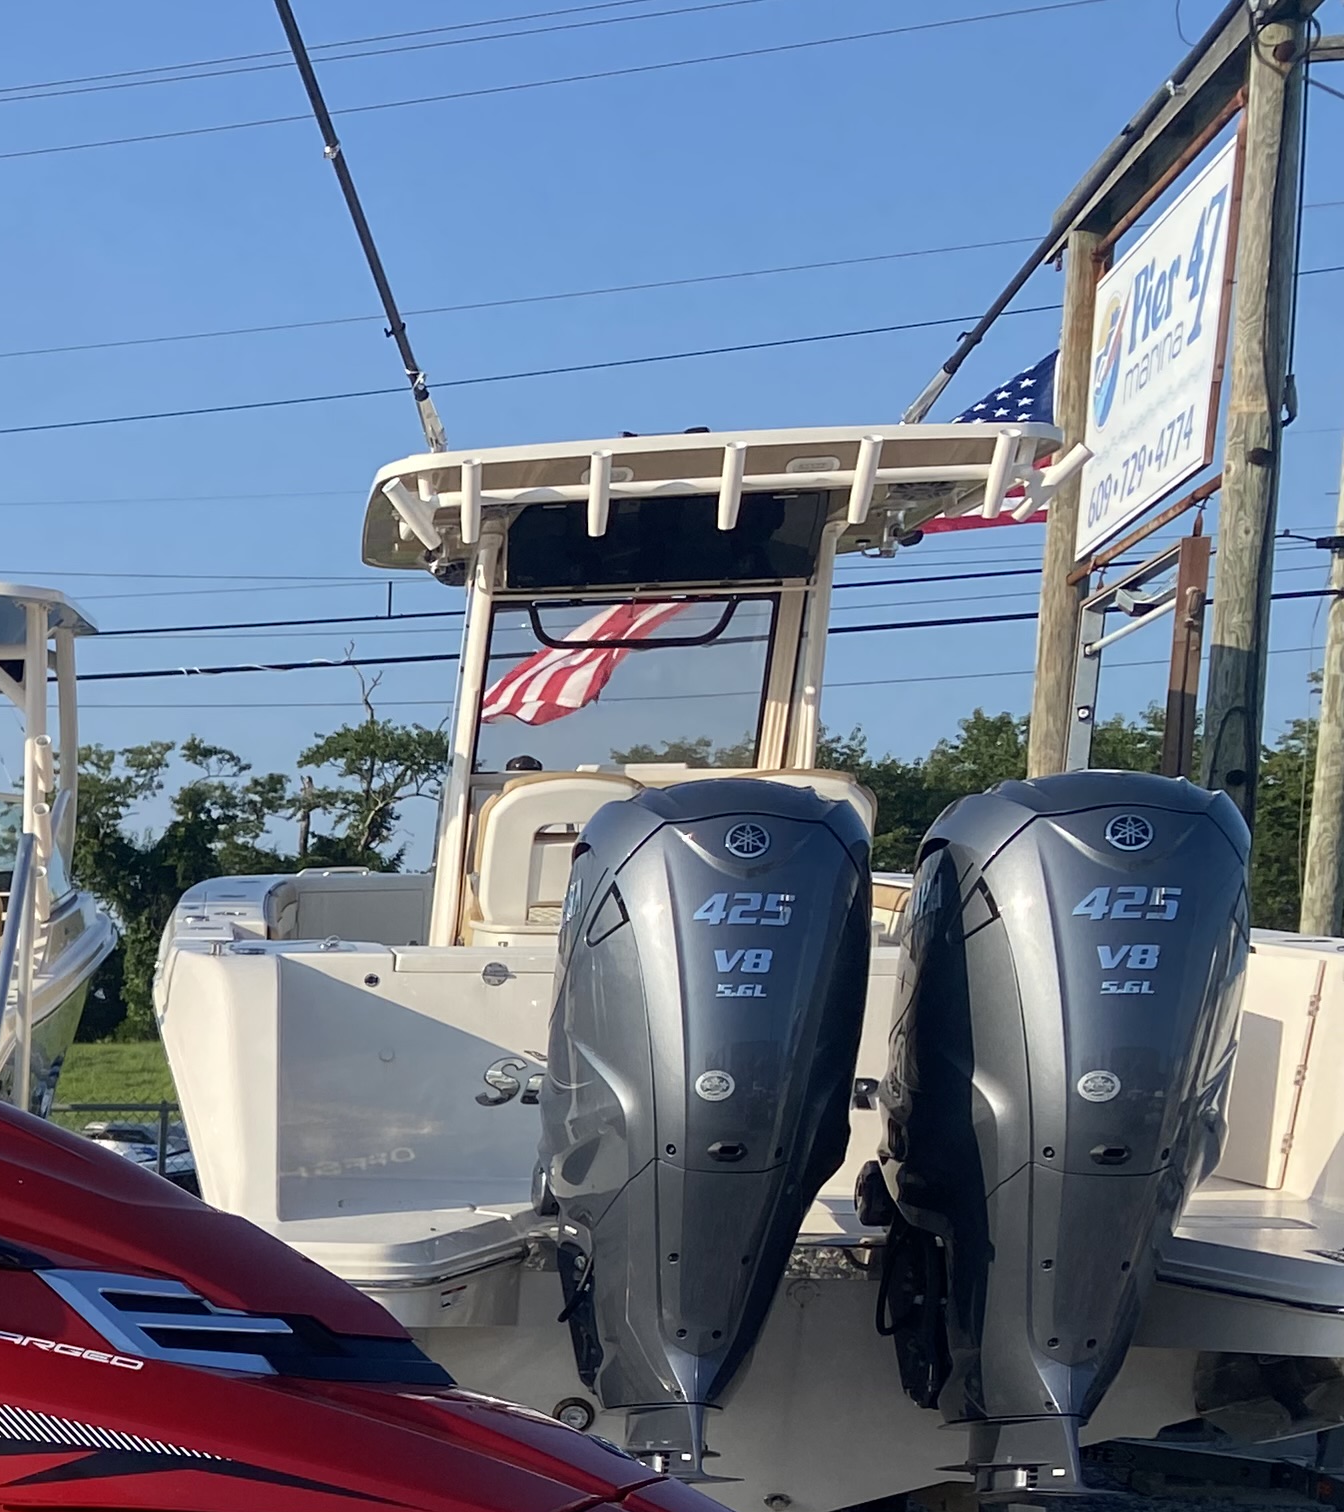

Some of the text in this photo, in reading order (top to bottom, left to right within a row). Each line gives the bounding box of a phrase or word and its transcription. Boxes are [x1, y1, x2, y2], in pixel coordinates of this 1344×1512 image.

[1128, 183, 1229, 355] Pier 47
[1123, 321, 1184, 405] marina
[692, 892, 796, 926] 425
[1072, 886, 1182, 921] 425
[714, 949, 773, 973] V8
[1097, 944, 1160, 970] V8
[715, 983, 767, 998] 5.6L
[1100, 981, 1154, 994] 5.6L
